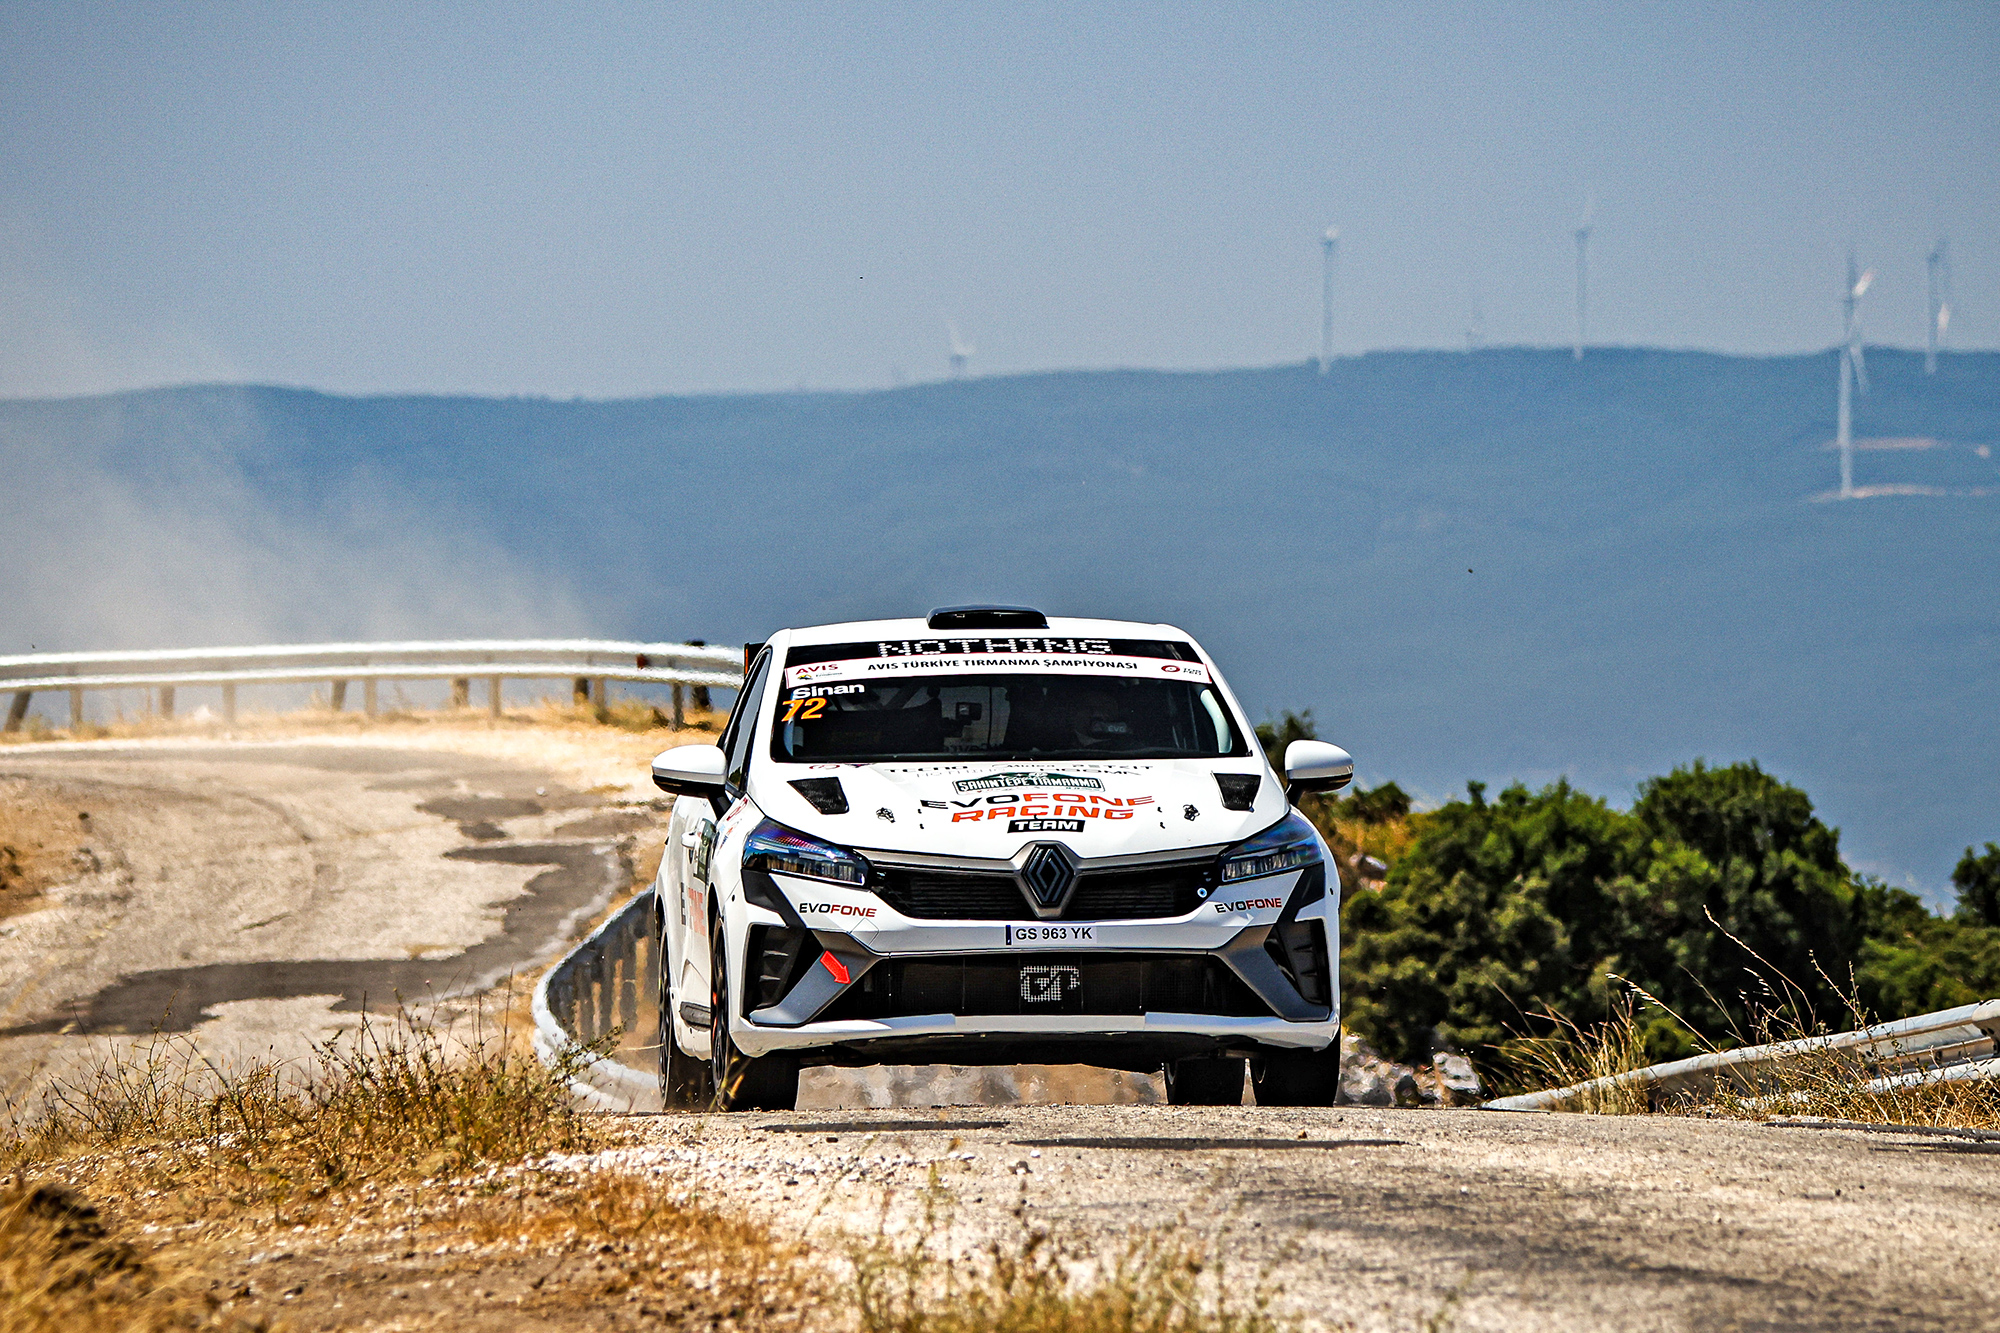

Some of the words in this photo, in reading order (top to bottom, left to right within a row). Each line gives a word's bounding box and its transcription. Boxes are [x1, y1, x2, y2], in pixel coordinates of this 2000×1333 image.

[878, 639, 1111, 658] NOTHING
[795, 664, 839, 675] AVIS
[867, 662, 899, 671] AVIS
[902, 659, 960, 669] TÜRKİYE
[963, 659, 1040, 667] TIRMANMA
[1043, 659, 1138, 670] ŞAMPİYONASI
[792, 684, 865, 700] Sinan
[781, 697, 828, 722] 72
[920, 793, 1155, 809] EVOFONE
[952, 805, 1133, 822] RACING
[1014, 820, 1079, 831] TEAM
[799, 902, 877, 917] EVOFONE
[1214, 898, 1283, 913] EVOFONE
[1016, 928, 1038, 940] GS
[1041, 928, 1067, 940] 963
[1071, 927, 1093, 940] YK
